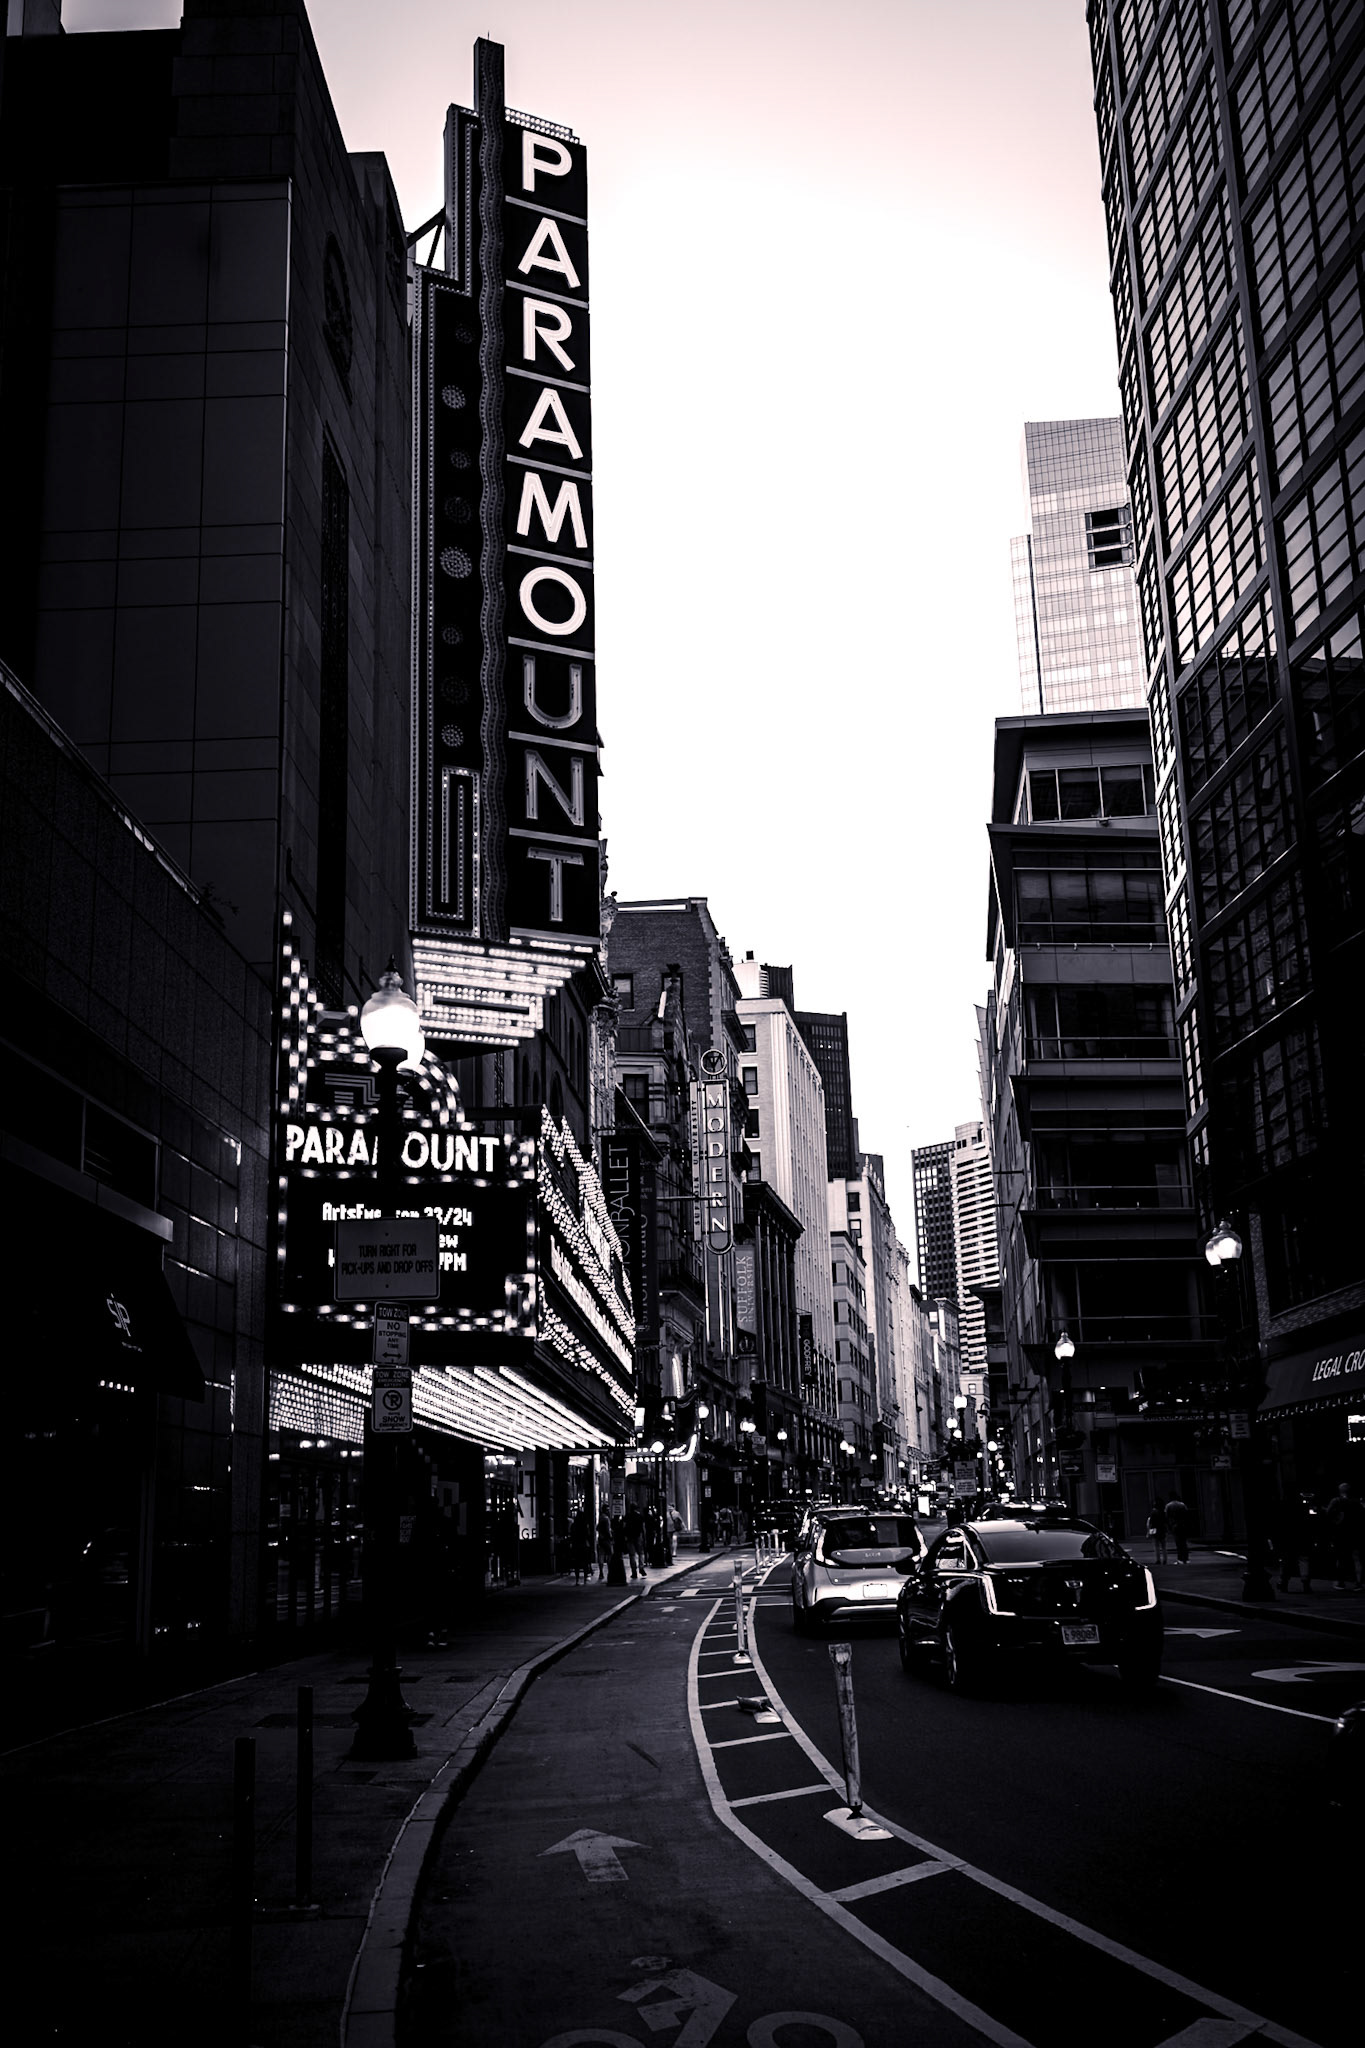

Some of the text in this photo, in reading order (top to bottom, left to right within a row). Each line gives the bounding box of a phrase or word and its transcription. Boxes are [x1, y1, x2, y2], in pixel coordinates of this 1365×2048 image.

[516, 129, 588, 922] PARAMOUNT
[691, 1099, 699, 1165] UNIVERSITY
[286, 1124, 501, 1172] PARAOUNT
[707, 1093, 727, 1232] MODERN
[359, 1243, 417, 1258] TURN RIGHT FOR
[341, 1260, 434, 1275] PICK-UPS AND DROP OFFS
[736, 1255, 748, 1324] SUFFOLK
[745, 1255, 754, 1323] UNIVERSITY
[378, 1306, 408, 1319] TOW ZONE
[387, 1321, 400, 1331] NO
[378, 1330, 407, 1338] STOPPING
[803, 1338, 812, 1377] GODFREY
[1312, 1355, 1344, 1382] LEGAL
[375, 1370, 410, 1379] TOW ZONE
[382, 1415, 406, 1423] SNOW
